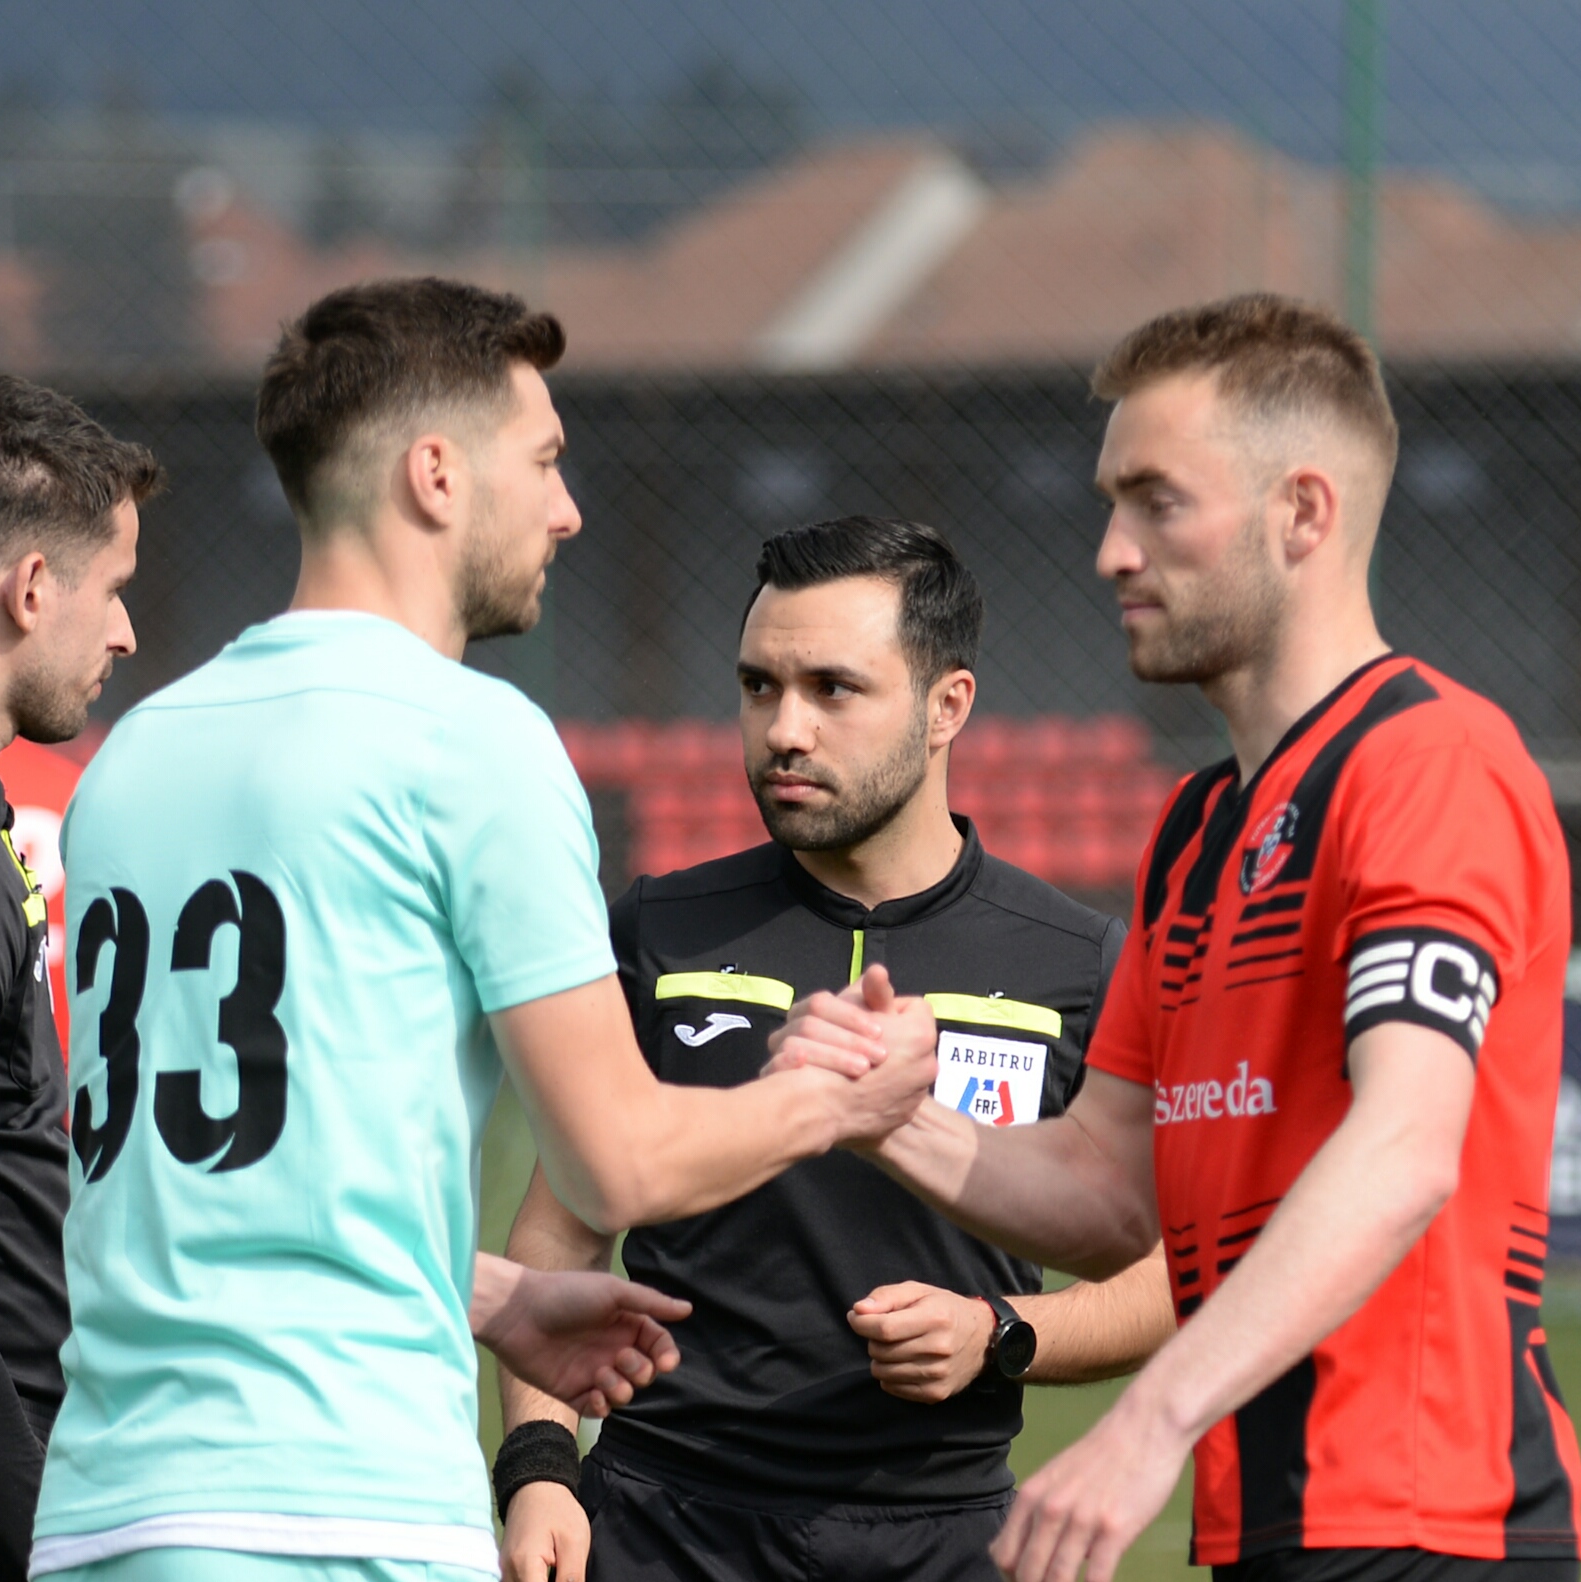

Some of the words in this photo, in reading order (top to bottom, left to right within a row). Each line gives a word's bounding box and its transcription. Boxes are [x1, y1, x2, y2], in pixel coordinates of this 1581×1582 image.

[71, 869, 288, 1184] 33
[949, 1046, 1035, 1072] ARBITRU
[974, 1097, 999, 1116] FRF
[1154, 1058, 1279, 1125] szereda
